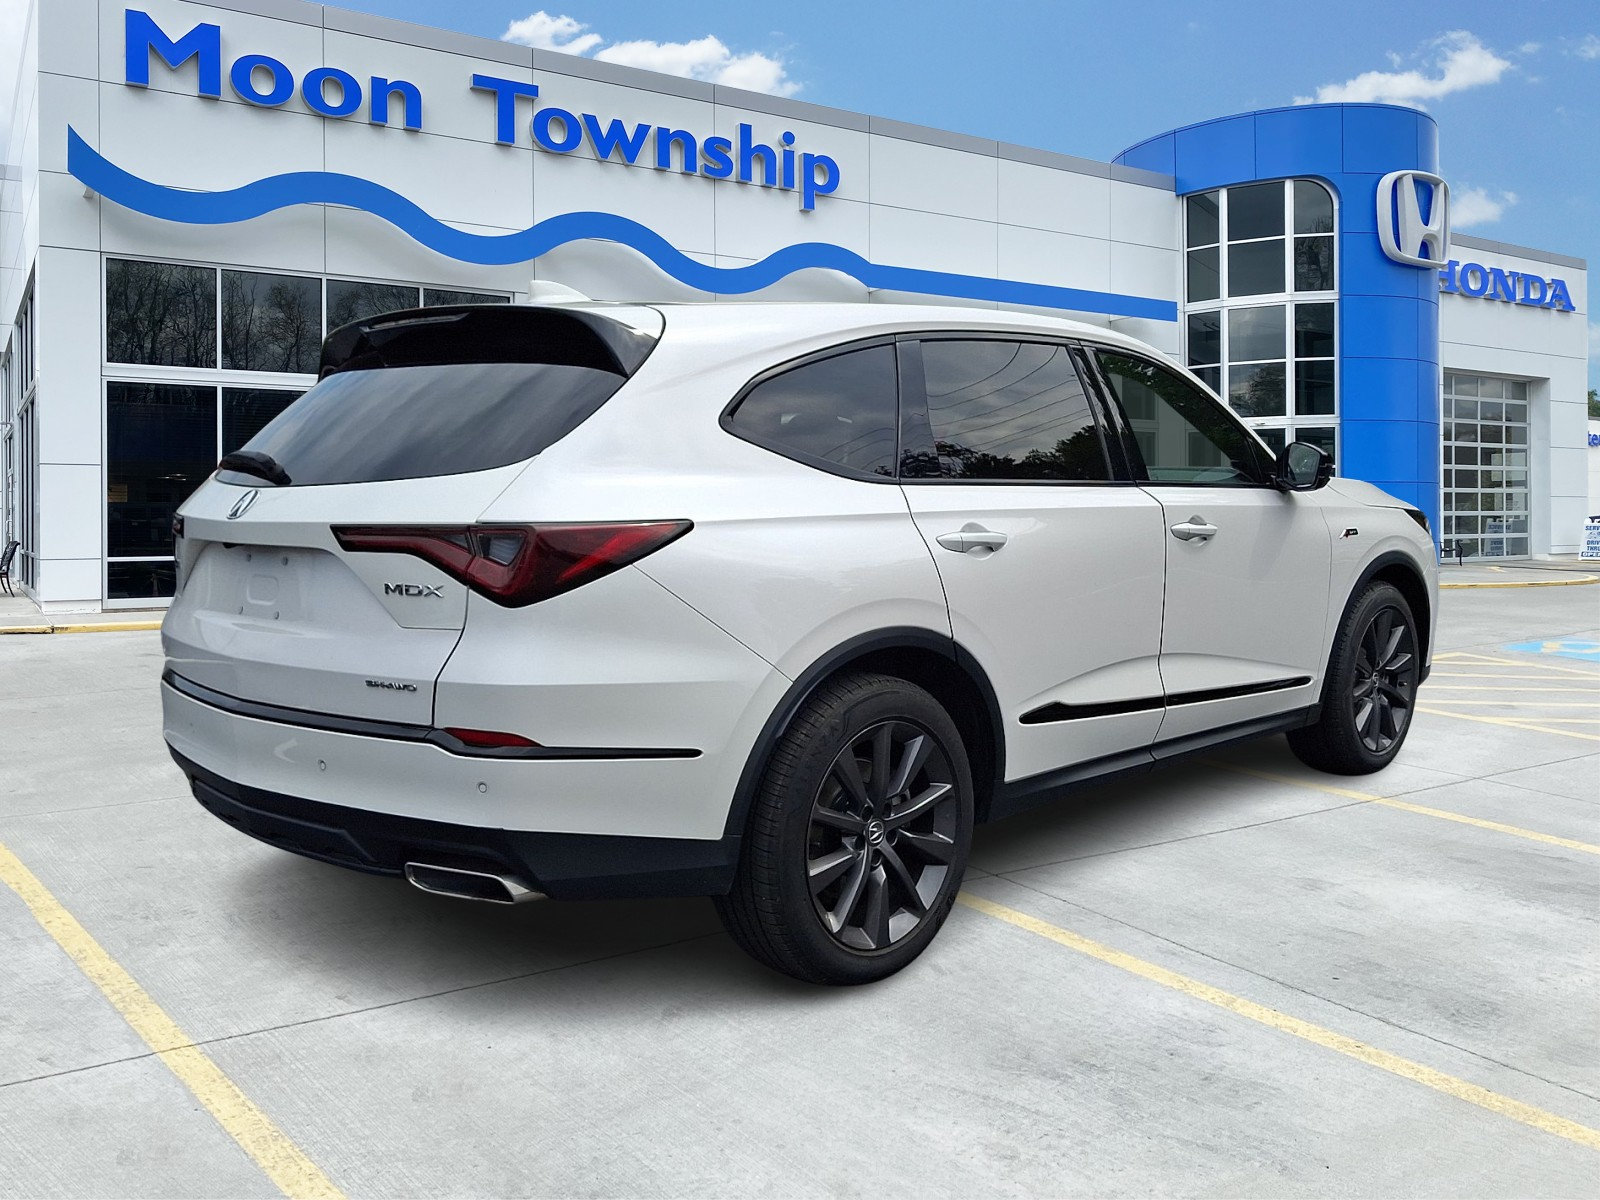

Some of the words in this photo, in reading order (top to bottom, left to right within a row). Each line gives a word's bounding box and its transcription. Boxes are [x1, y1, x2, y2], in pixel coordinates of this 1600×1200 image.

[124, 8, 422, 132] Moon
[470, 73, 841, 212] Township
[1439, 259, 1576, 312] HONDA
[384, 582, 444, 598] MDX
